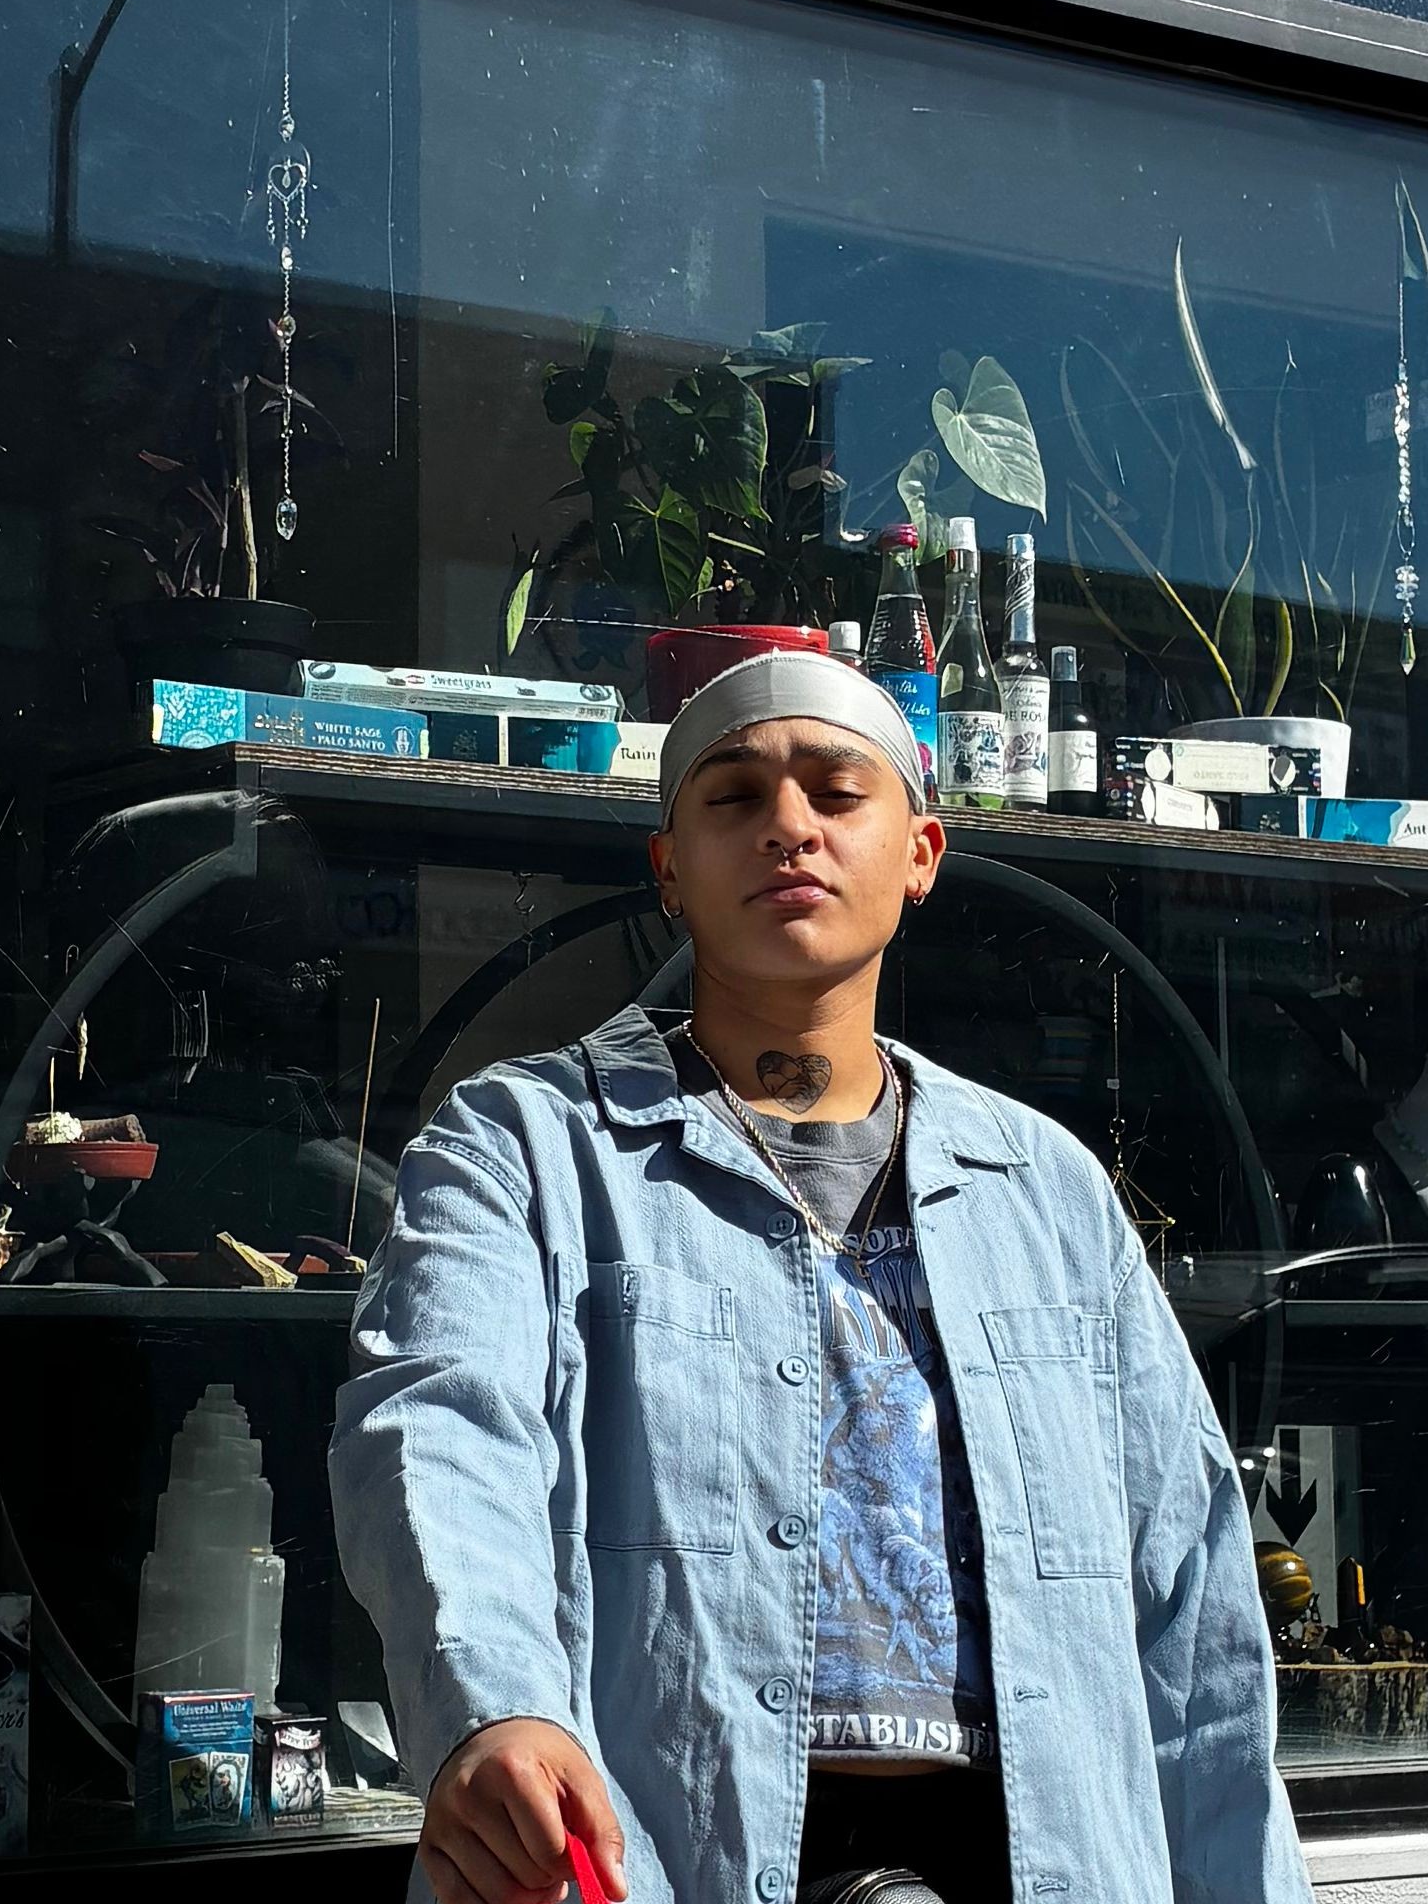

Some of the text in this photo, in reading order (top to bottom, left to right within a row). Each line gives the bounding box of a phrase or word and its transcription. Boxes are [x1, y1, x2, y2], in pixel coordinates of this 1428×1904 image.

[314, 721, 382, 739] WHITE SAGE
[317, 735, 385, 751] PALO SANTO
[621, 747, 656, 760] Rain
